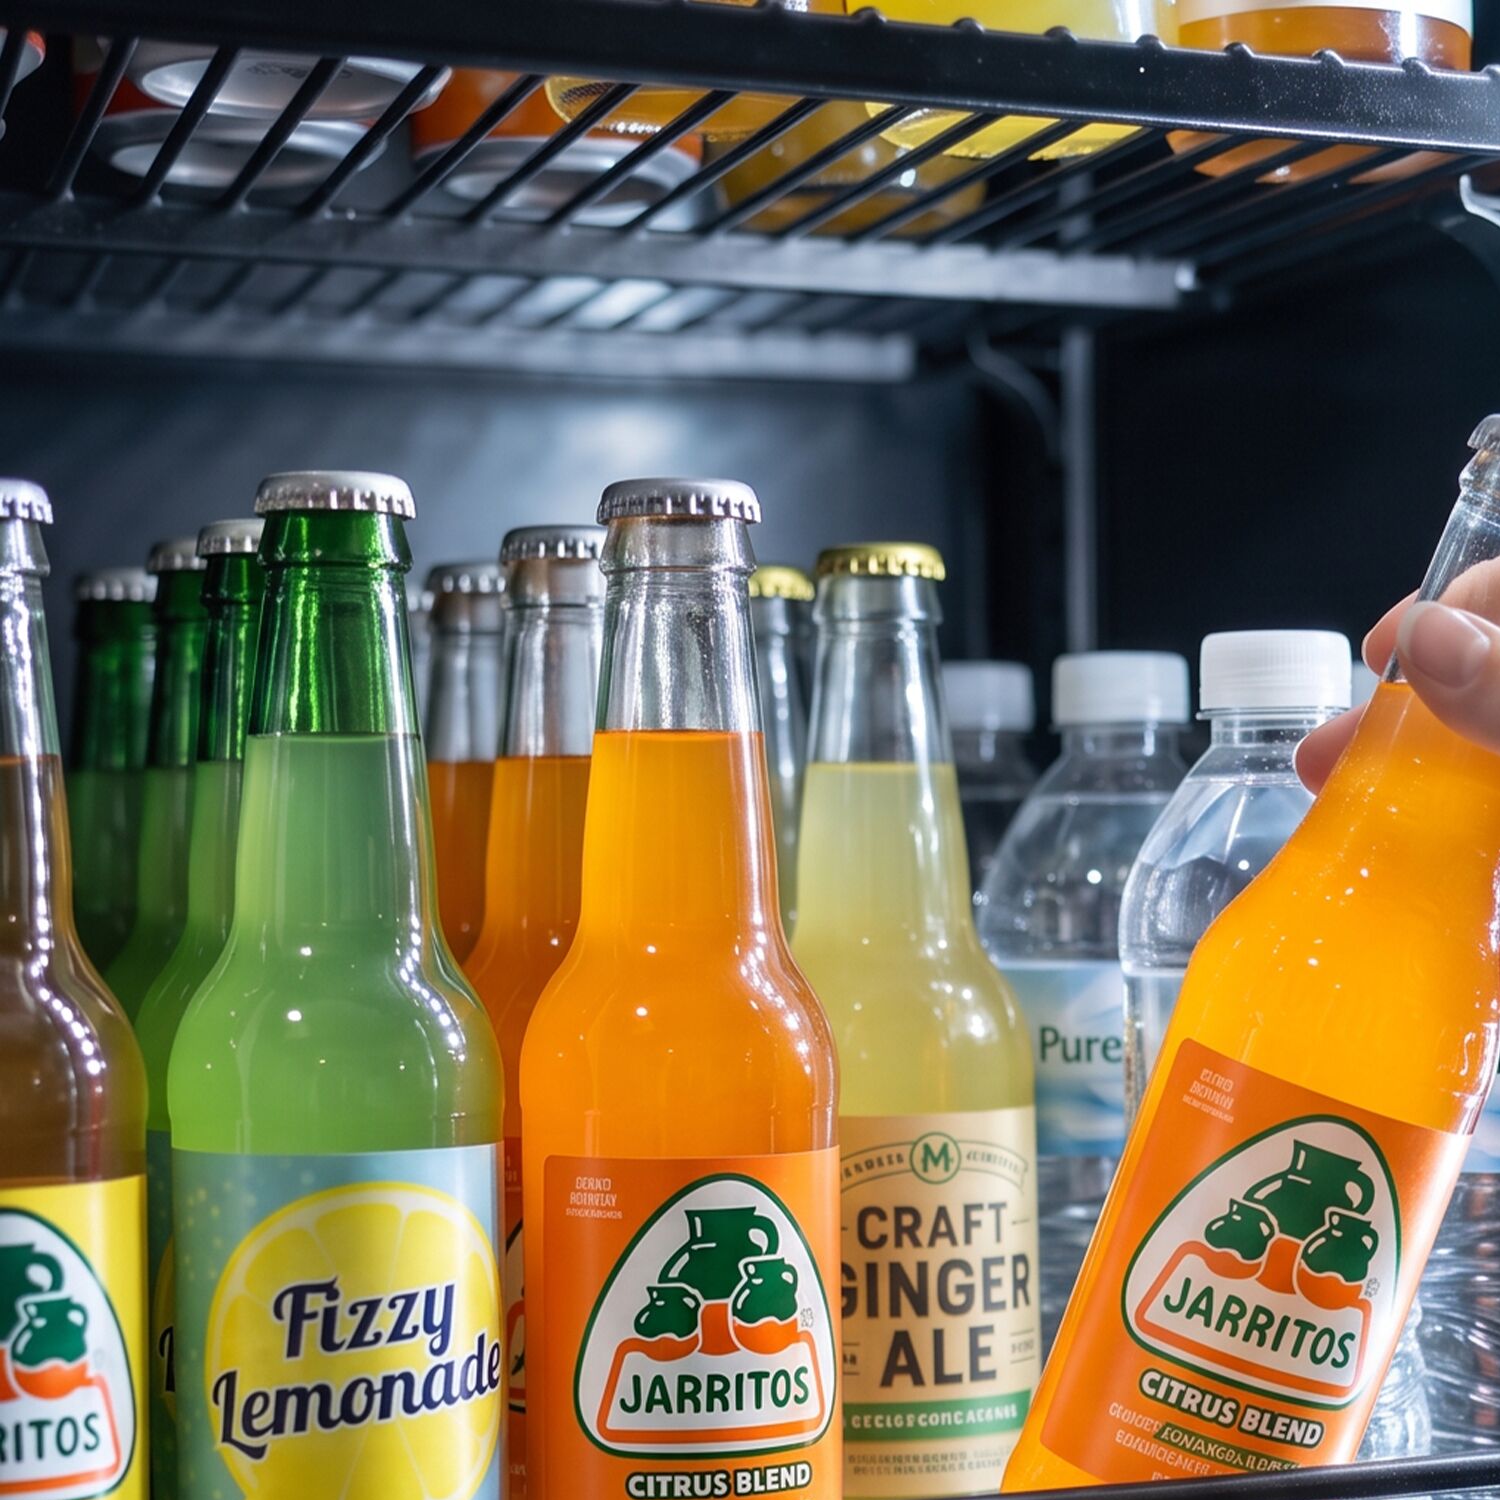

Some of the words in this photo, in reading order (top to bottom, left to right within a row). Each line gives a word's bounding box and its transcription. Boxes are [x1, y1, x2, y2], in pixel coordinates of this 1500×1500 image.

[857, 1201, 1007, 1249] CRAFT
[273, 1276, 456, 1358] Fizzy
[1163, 1276, 1356, 1369] JARRITOS
[619, 1366, 809, 1415] JARRITOS
[879, 1324, 997, 1388] ALE
[212, 1333, 501, 1459] Lemonade
[1141, 1370, 1237, 1426] CITRUS
[1240, 1408, 1322, 1445] BLEND
[628, 1473, 728, 1497] CITRUS
[737, 1463, 810, 1493] BLEND
